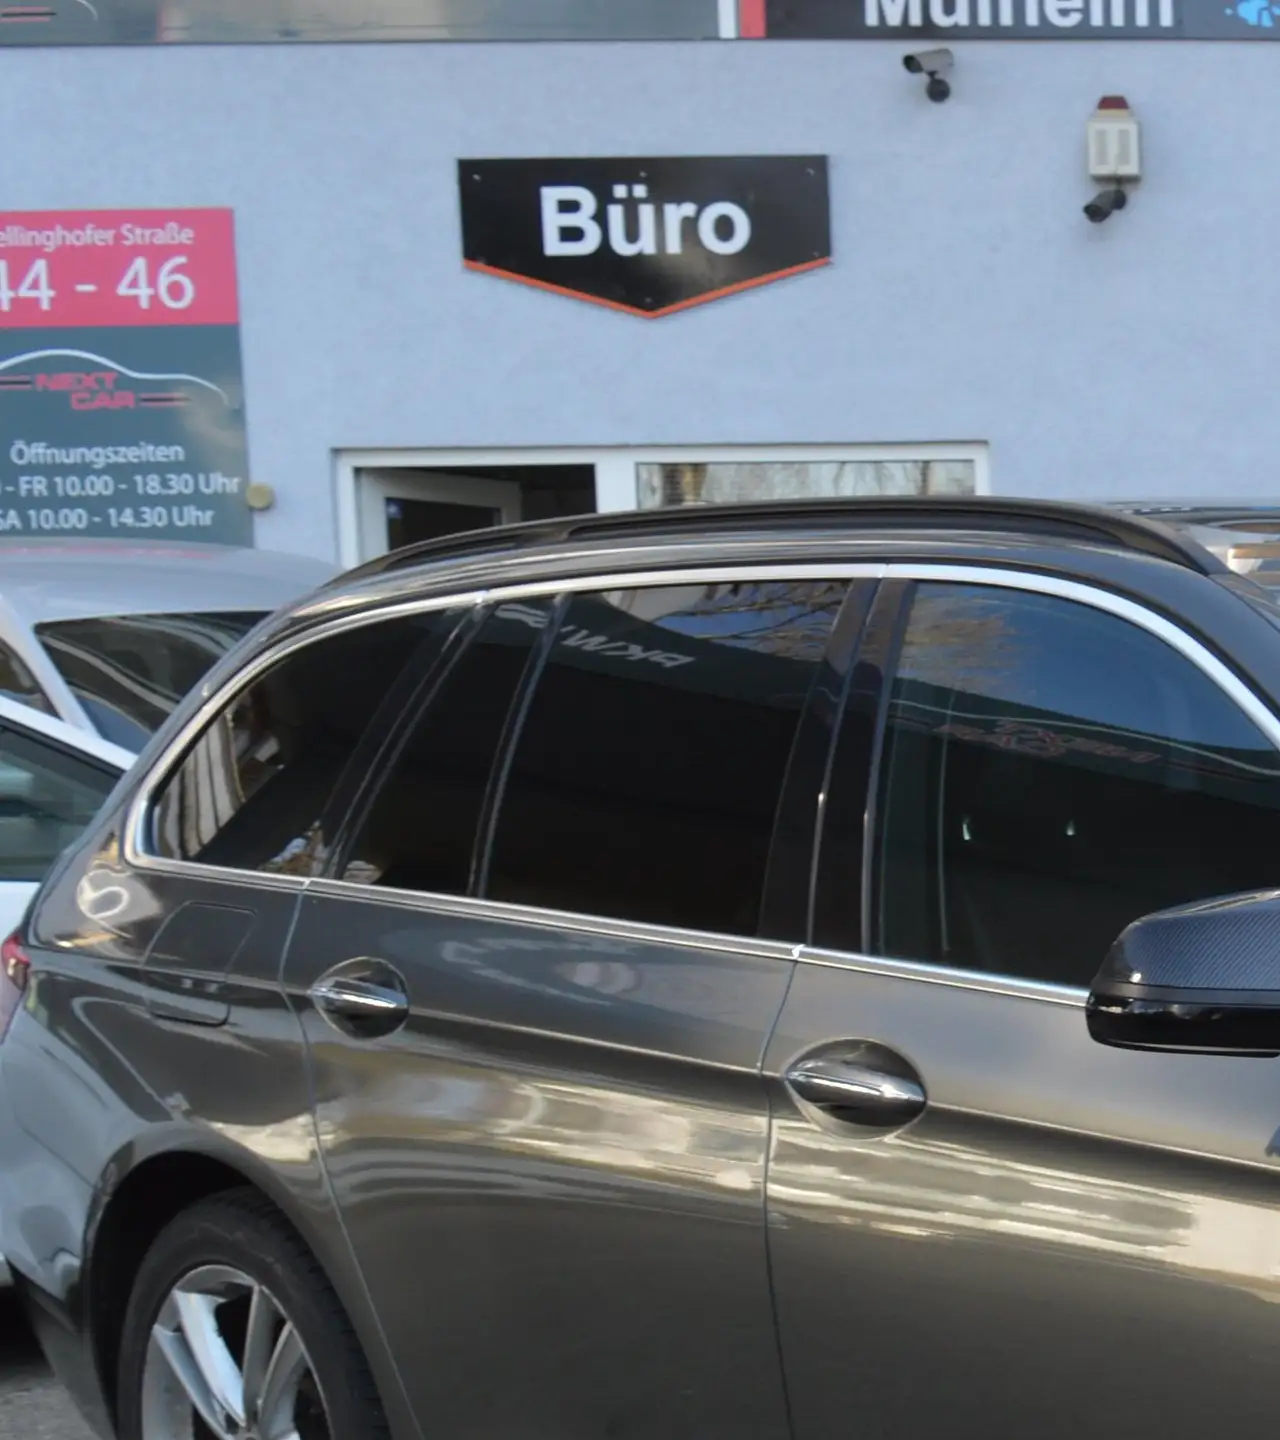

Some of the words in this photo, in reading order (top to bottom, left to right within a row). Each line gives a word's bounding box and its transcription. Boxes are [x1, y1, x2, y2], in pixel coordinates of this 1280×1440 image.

[120, 221, 195, 246] Straße
[539, 184, 752, 257] Büro
[115, 255, 196, 310] 46
[35, 372, 118, 391] NEXT
[70, 390, 136, 411] CAR
[9, 441, 186, 469] Öffnungszeiten
[19, 475, 48, 498] FR
[53, 475, 115, 497] 10.00
[133, 473, 194, 495] 18.30
[198, 471, 242, 495] Uhr
[27, 508, 89, 530] 10.00
[107, 507, 169, 529] 14.30
[172, 505, 215, 527] Uhr
